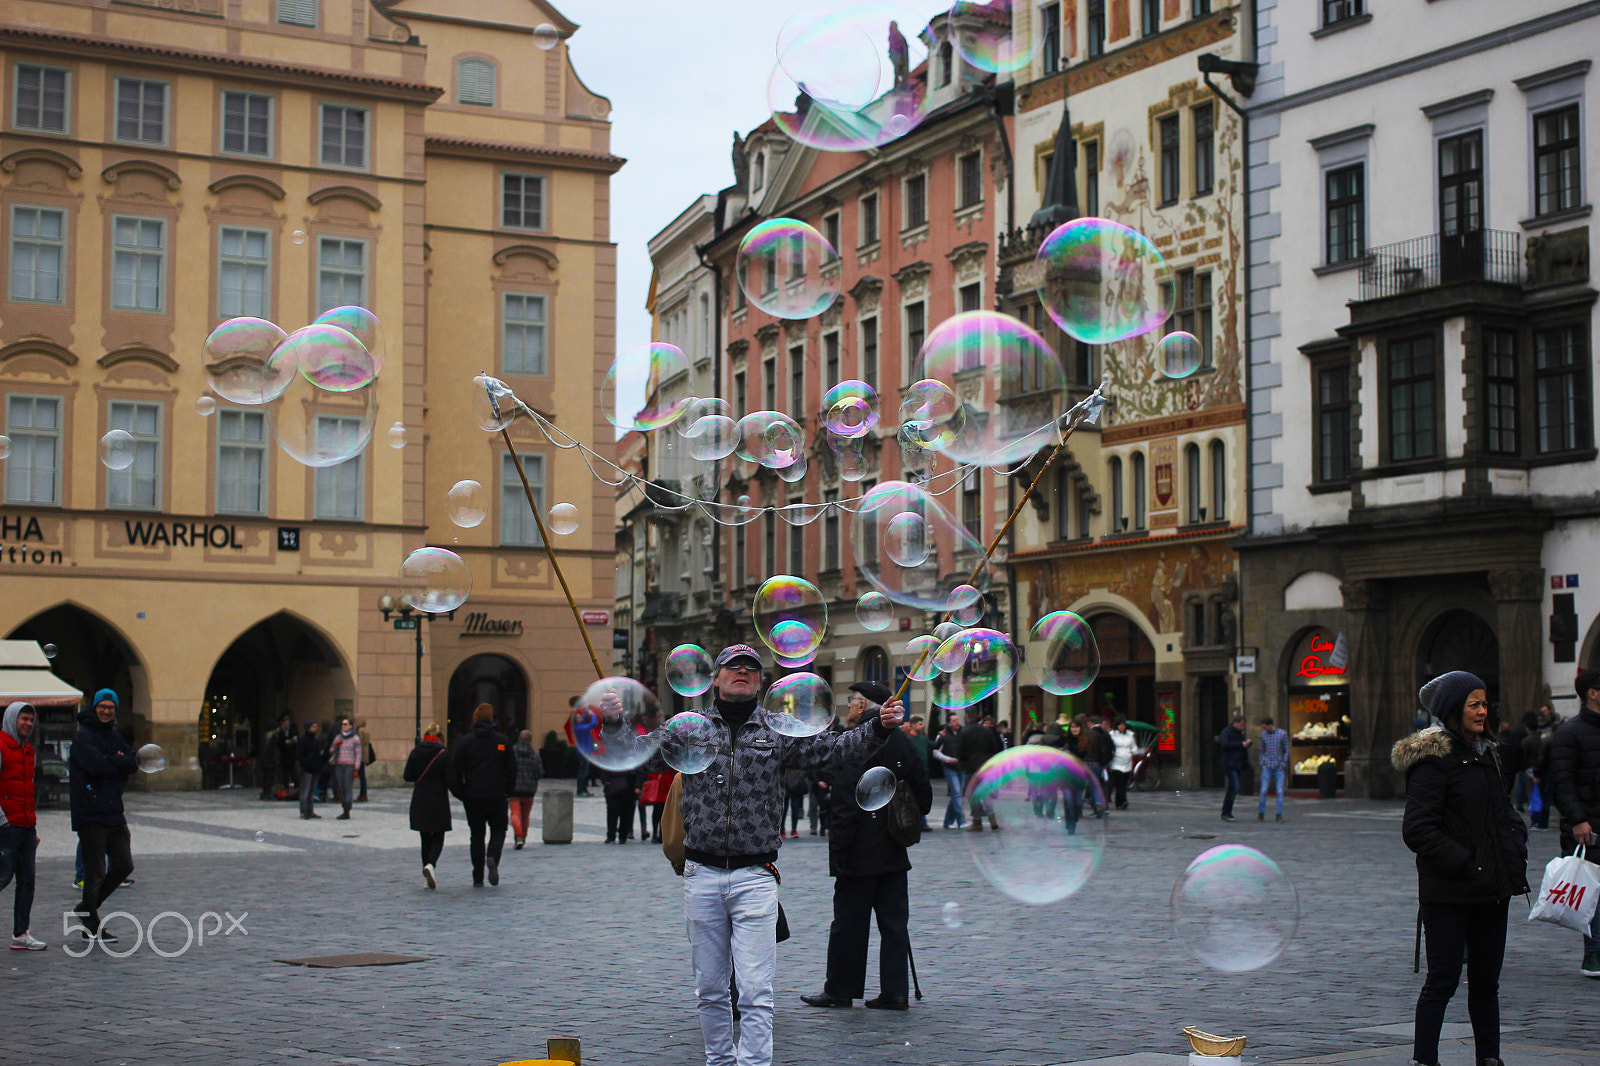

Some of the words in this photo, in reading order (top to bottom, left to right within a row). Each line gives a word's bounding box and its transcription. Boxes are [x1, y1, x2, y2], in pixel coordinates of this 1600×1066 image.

[0, 515, 43, 541] HA
[125, 520, 243, 549] WARHOL
[461, 612, 524, 637] Moser
[1545, 881, 1586, 911] H&M
